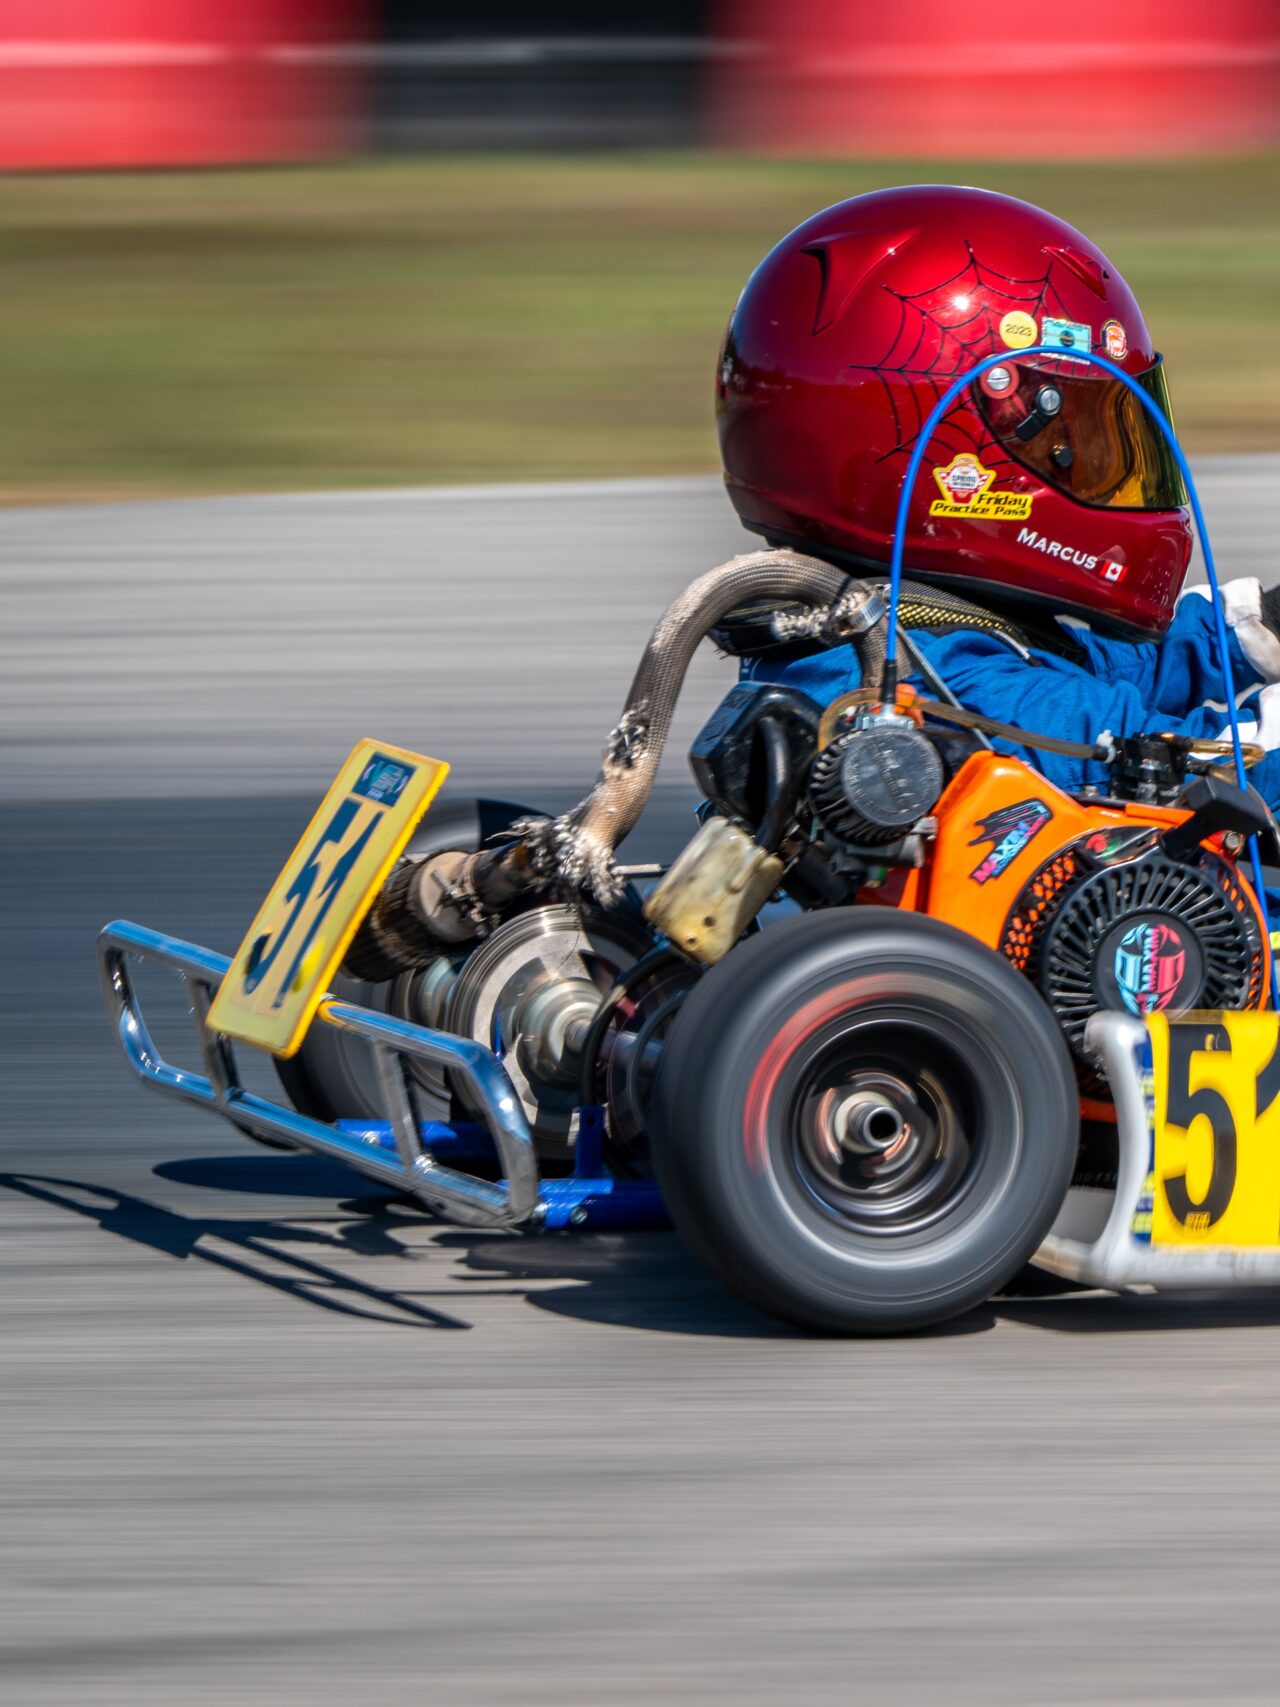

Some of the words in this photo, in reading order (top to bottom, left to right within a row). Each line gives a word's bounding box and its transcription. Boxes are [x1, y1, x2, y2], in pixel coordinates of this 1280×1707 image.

[1005, 323, 1032, 337] 2023
[977, 493, 1028, 508] Friday
[934, 502, 990, 514] Practice
[994, 506, 1027, 516] Pass
[244, 797, 385, 1009] 51
[1140, 928, 1160, 992] MAXIM
